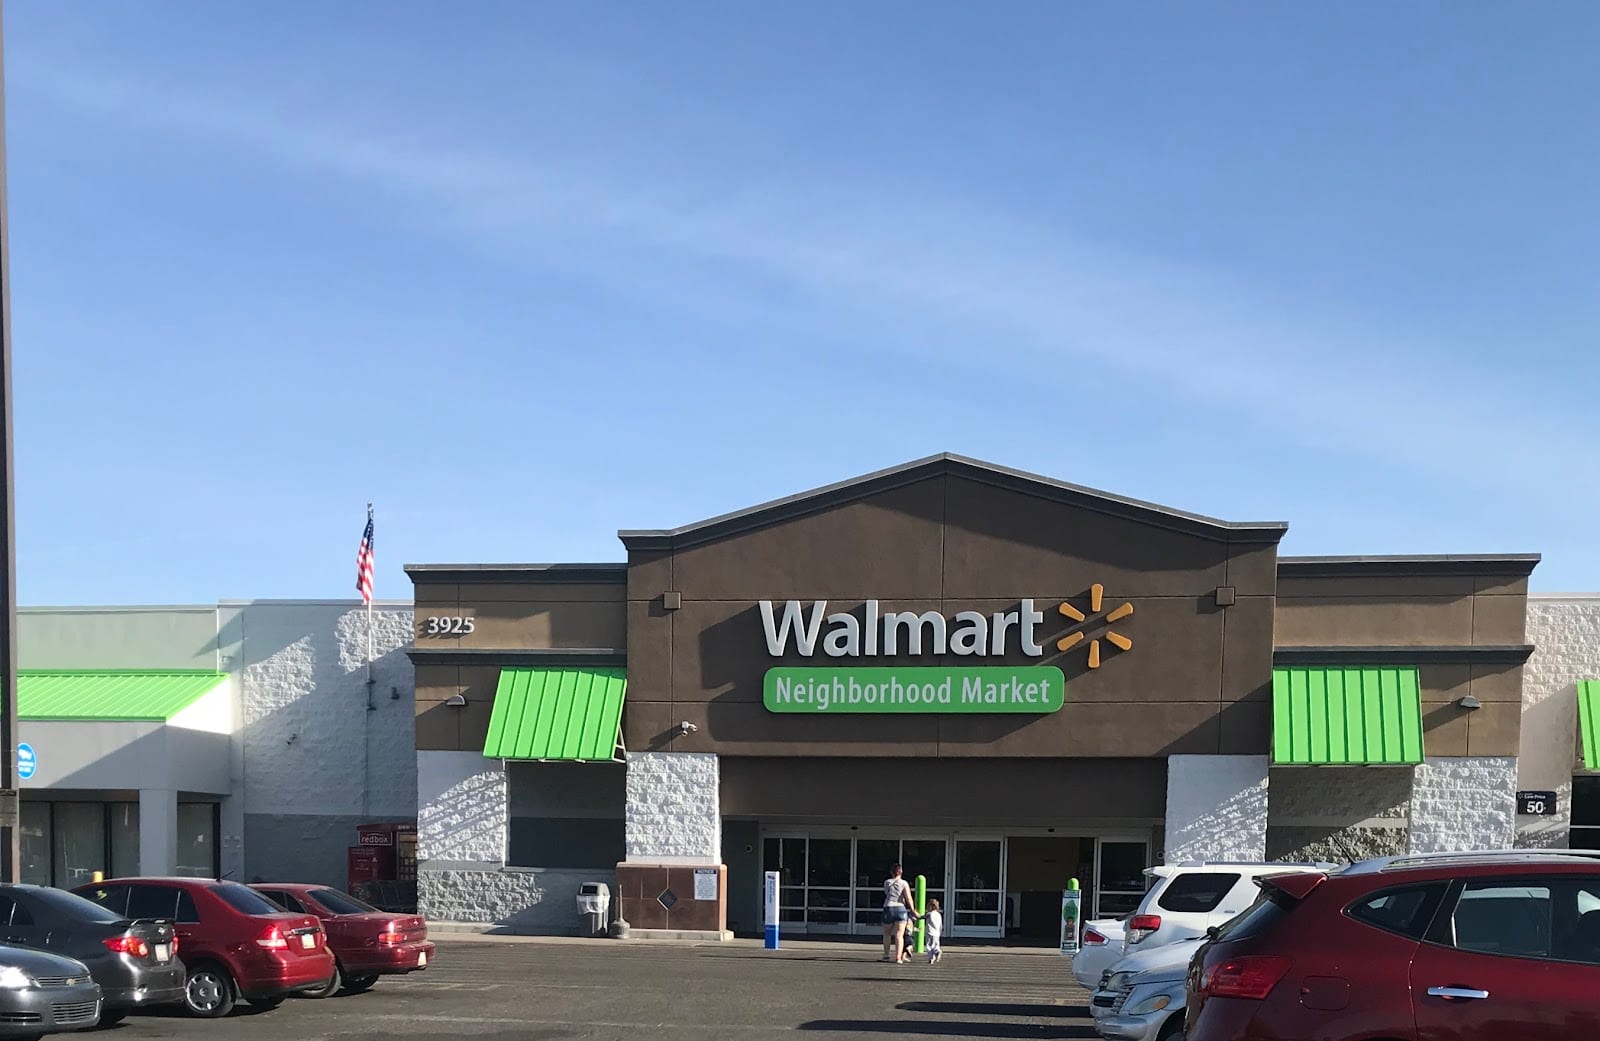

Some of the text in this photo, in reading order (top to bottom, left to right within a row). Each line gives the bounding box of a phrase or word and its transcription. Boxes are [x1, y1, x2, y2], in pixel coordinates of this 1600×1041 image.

[427, 616, 475, 634] 3925
[758, 598, 1044, 657] Walmart
[775, 676, 1050, 710] Neighborhood Market
[361, 835, 389, 844] redbox
